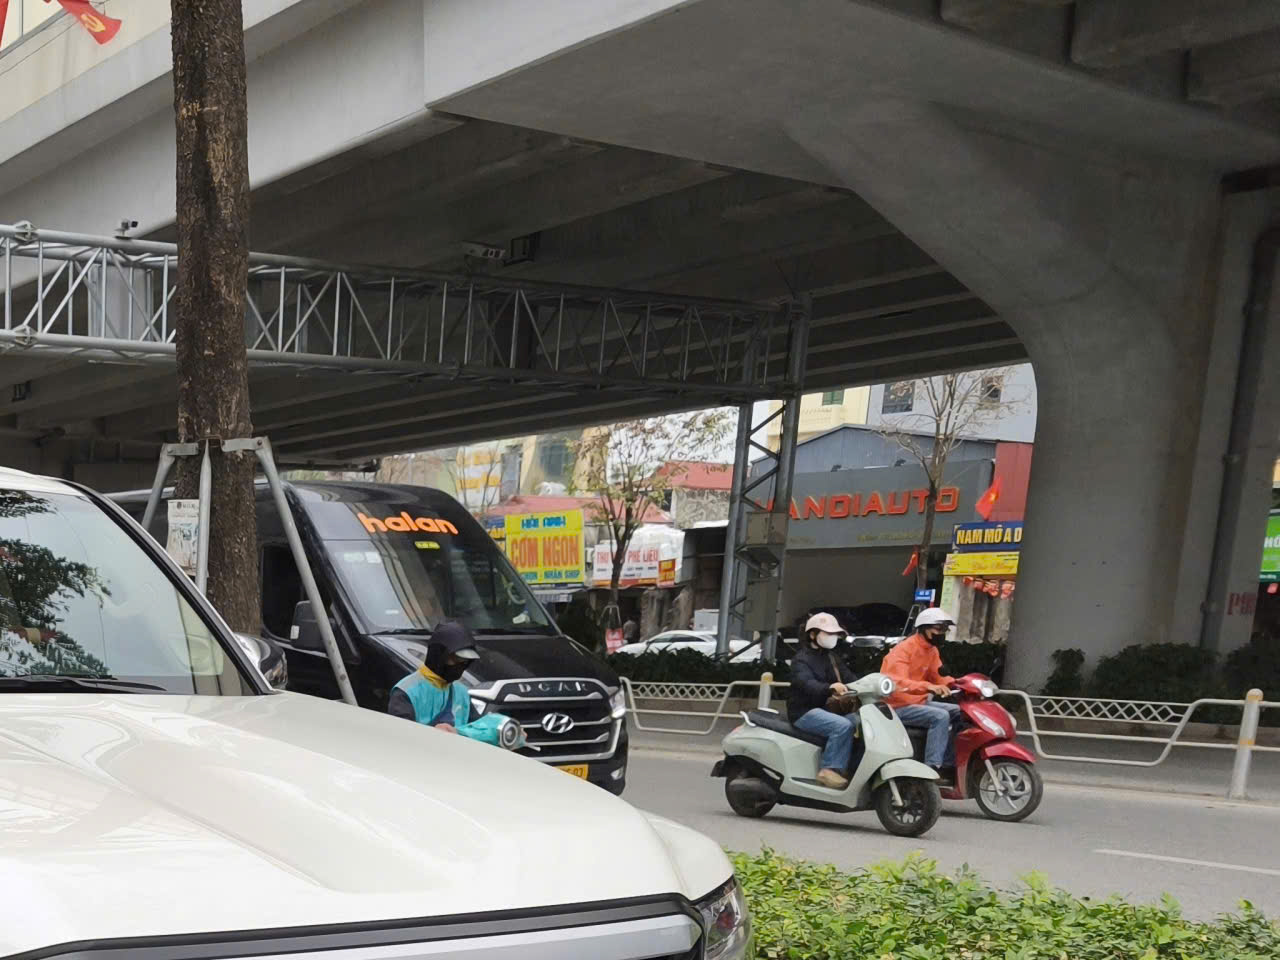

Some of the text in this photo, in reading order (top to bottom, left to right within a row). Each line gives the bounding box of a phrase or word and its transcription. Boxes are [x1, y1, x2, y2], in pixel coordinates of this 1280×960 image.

[357, 511, 459, 535] halan
[956, 529, 983, 545] NAM
[983, 524, 1004, 544] MÔ
[1003, 528, 1012, 543] A
[542, 533, 580, 568] NGON
